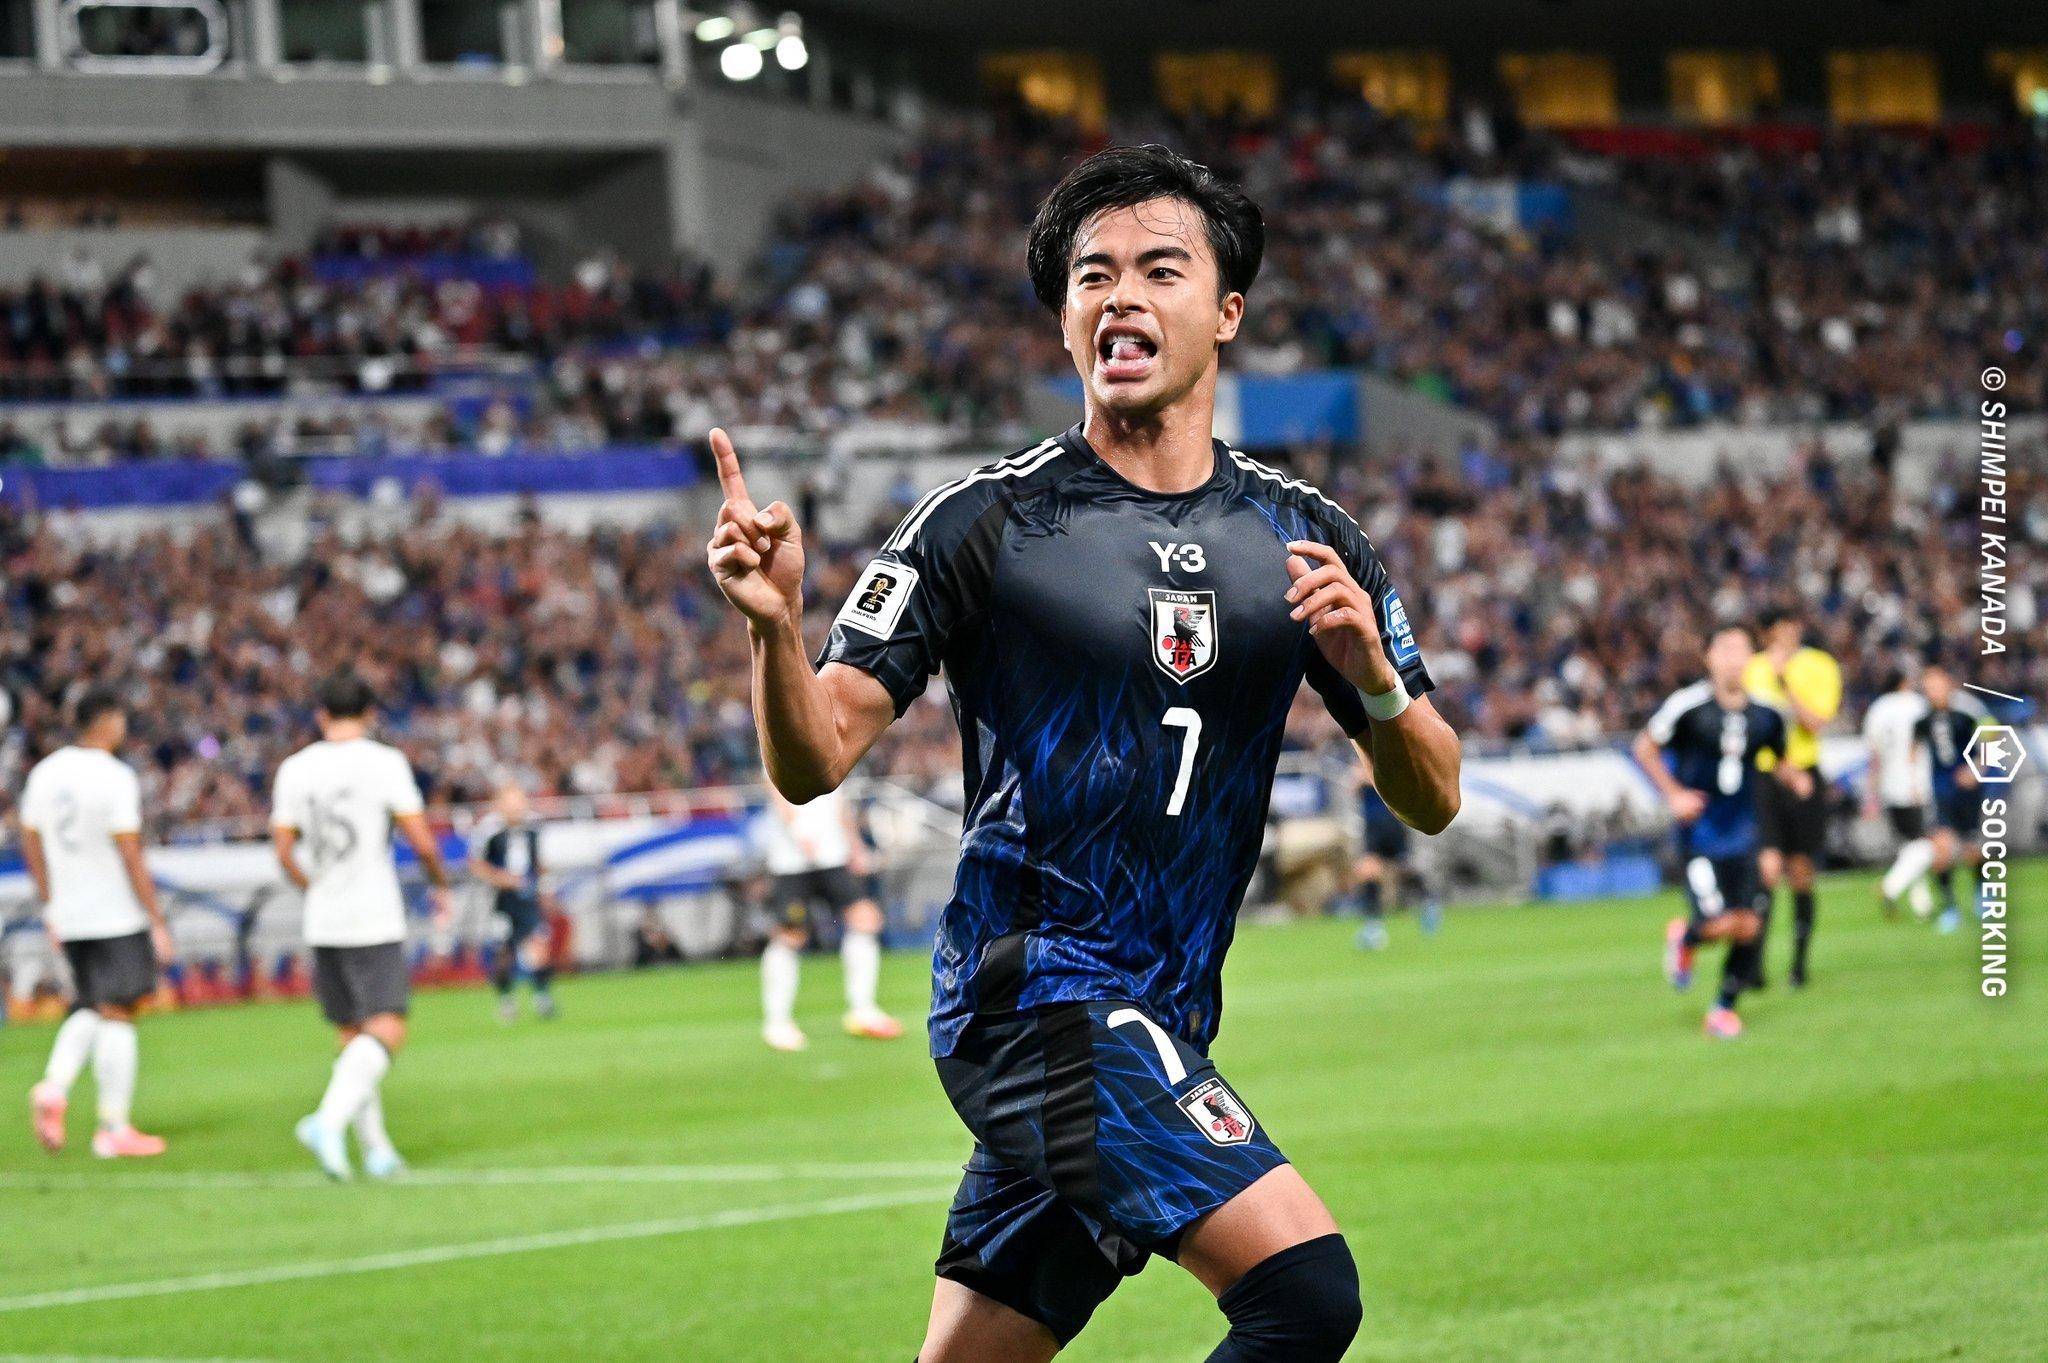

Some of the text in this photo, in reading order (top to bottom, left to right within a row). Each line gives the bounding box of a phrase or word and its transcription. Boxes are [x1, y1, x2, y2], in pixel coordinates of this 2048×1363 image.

[1148, 541, 1207, 573] Y-3
[1164, 593, 1198, 603] JAPAN
[1168, 651, 1198, 667] JFA
[1161, 706, 1203, 816] 7
[1106, 1008, 1188, 1086] 7
[1190, 1083, 1215, 1100] JAPAN
